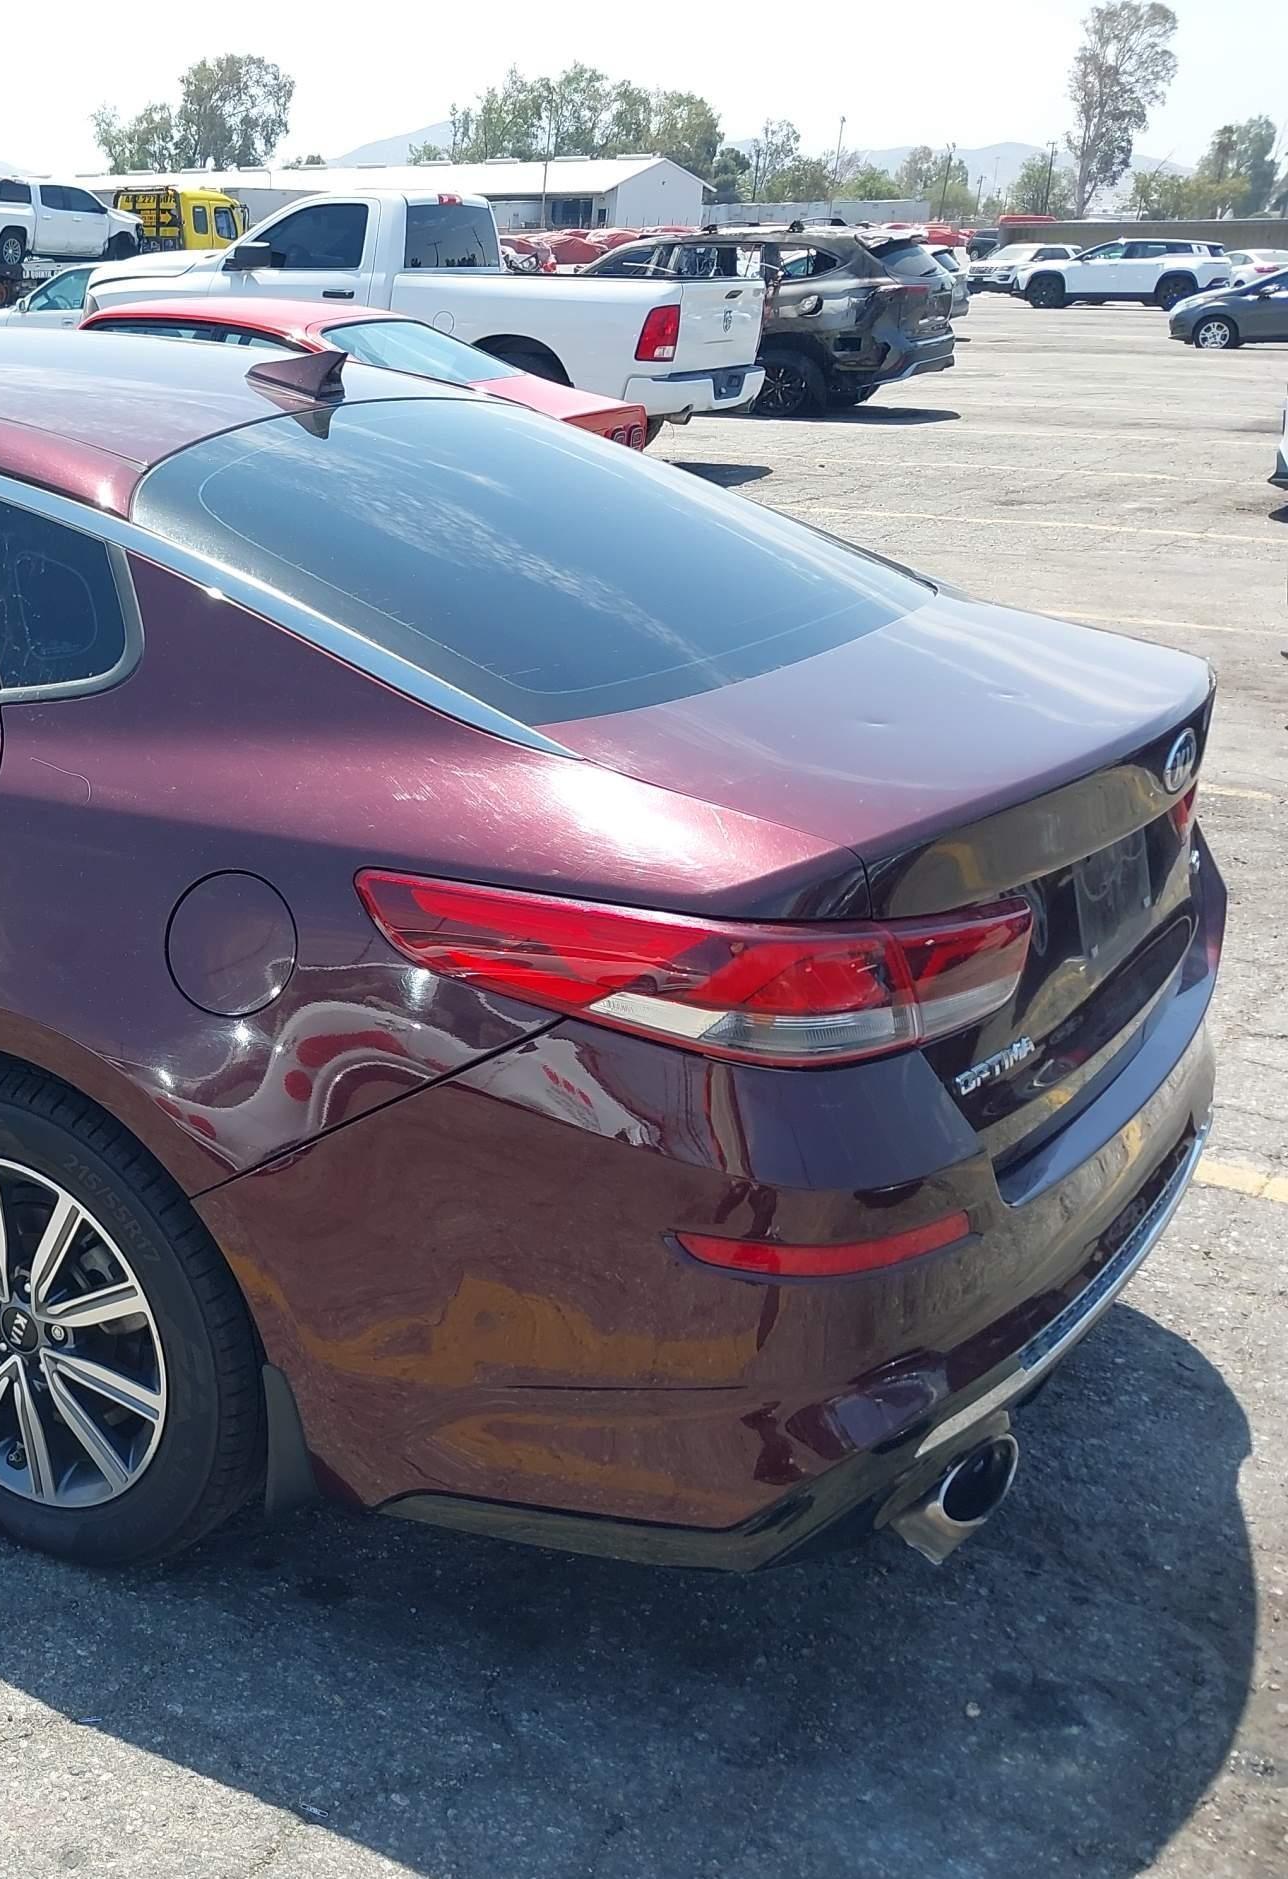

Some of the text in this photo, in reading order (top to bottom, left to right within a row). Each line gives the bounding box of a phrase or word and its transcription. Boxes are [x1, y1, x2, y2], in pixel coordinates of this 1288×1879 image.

[954, 1035, 1036, 1096] OPTIMA
[63, 1153, 161, 1261] 215/55R17
[10, 1311, 28, 1345] KIA
